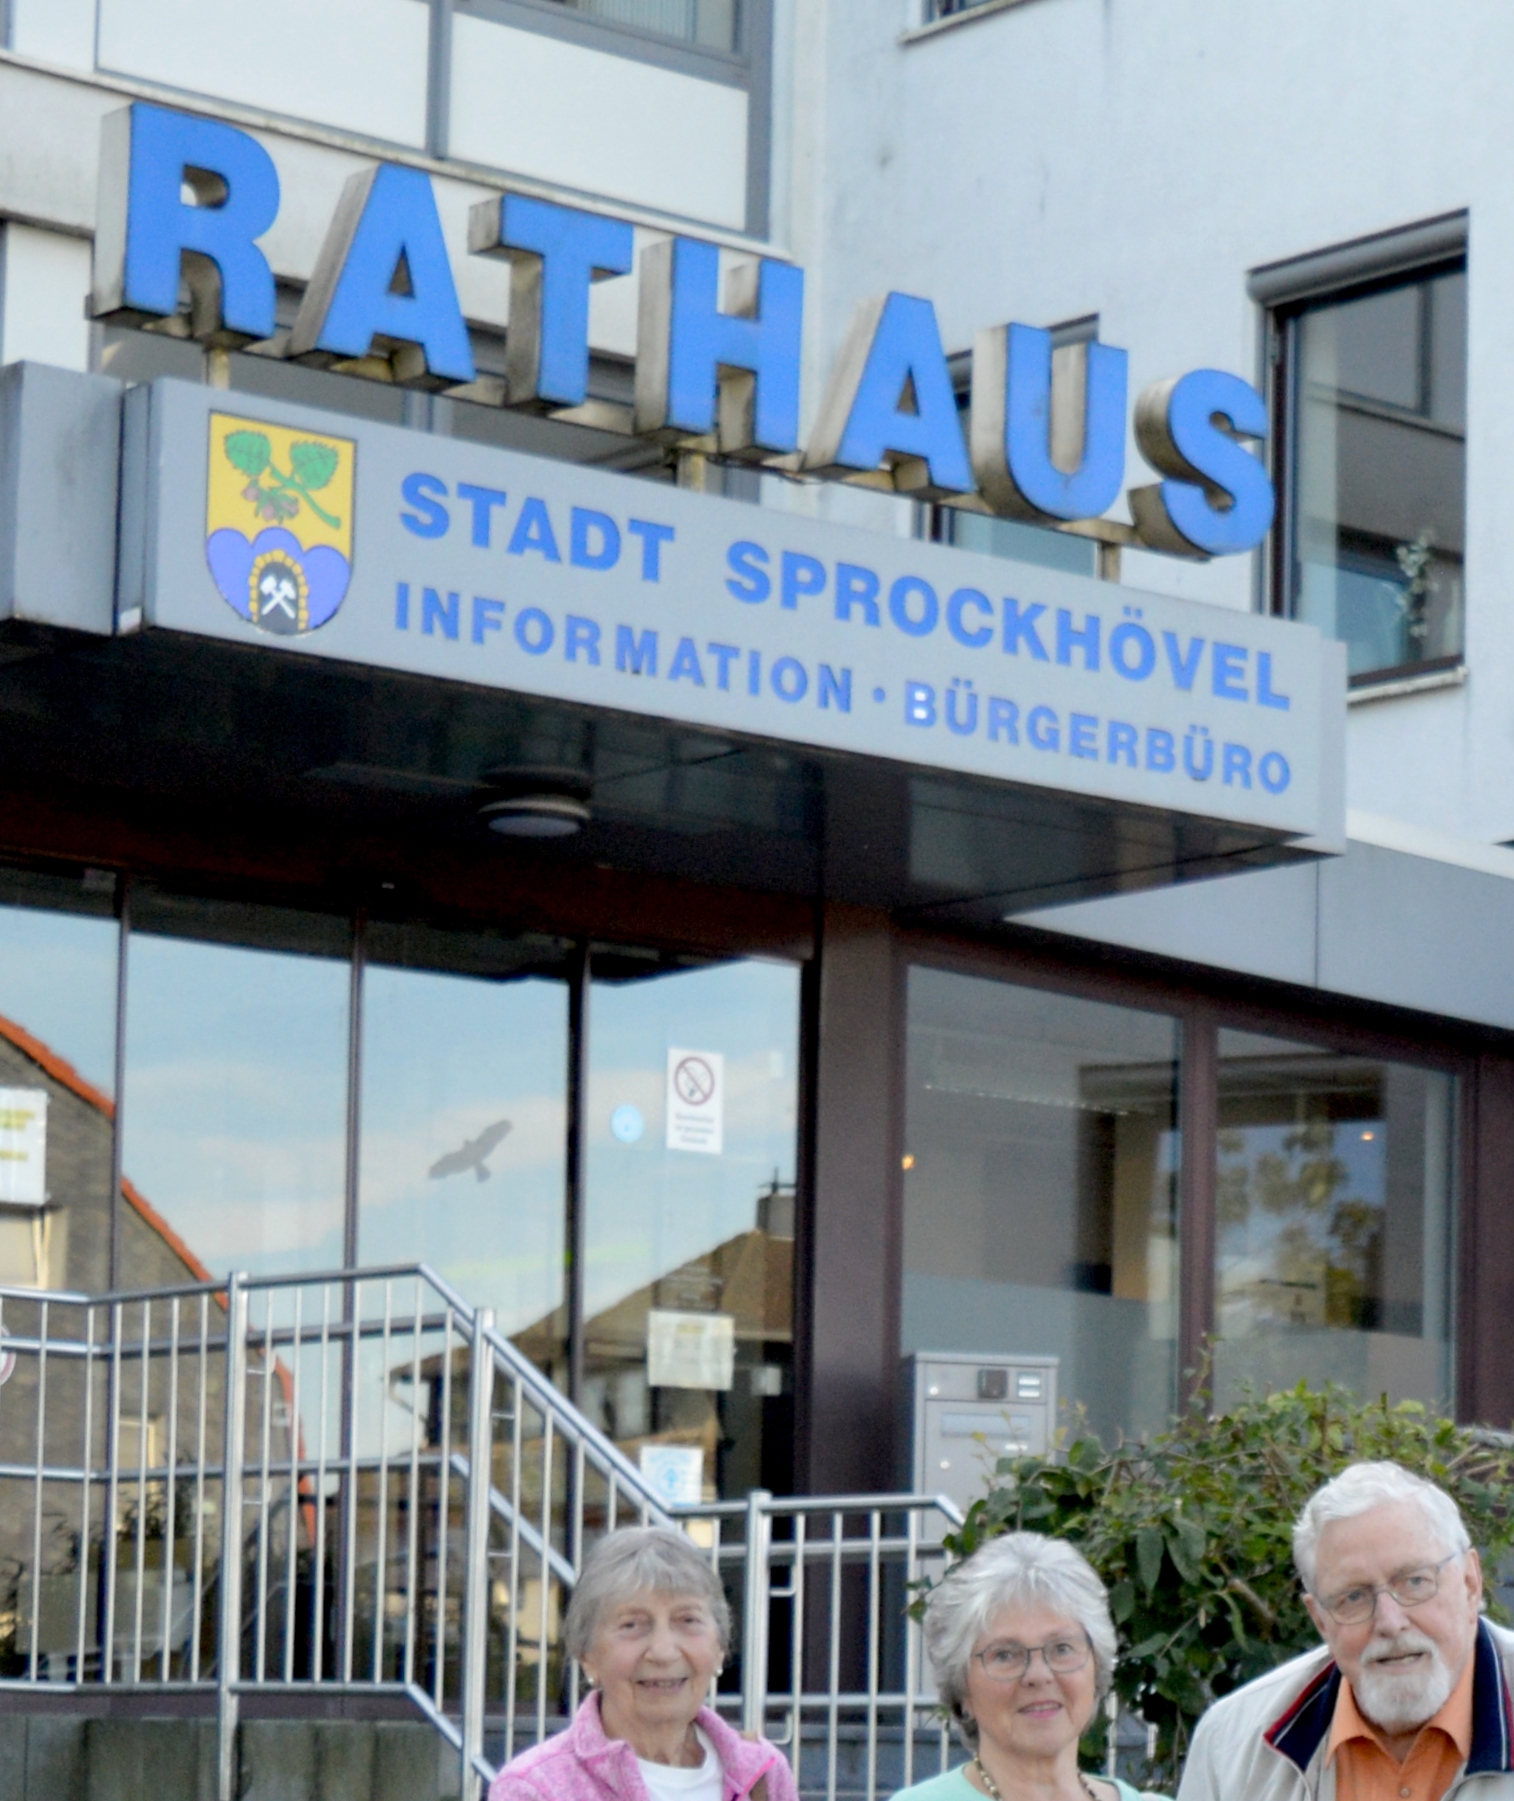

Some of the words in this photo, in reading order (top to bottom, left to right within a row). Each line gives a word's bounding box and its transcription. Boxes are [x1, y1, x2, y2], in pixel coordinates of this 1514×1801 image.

[118, 101, 1276, 558] RATHAUS
[394, 581, 852, 714] INFORMATION
[904, 676, 1291, 796] BÜRGERBÜRO
[399, 471, 676, 583] STADT
[724, 540, 1291, 712] SPROCKHÖVEL
